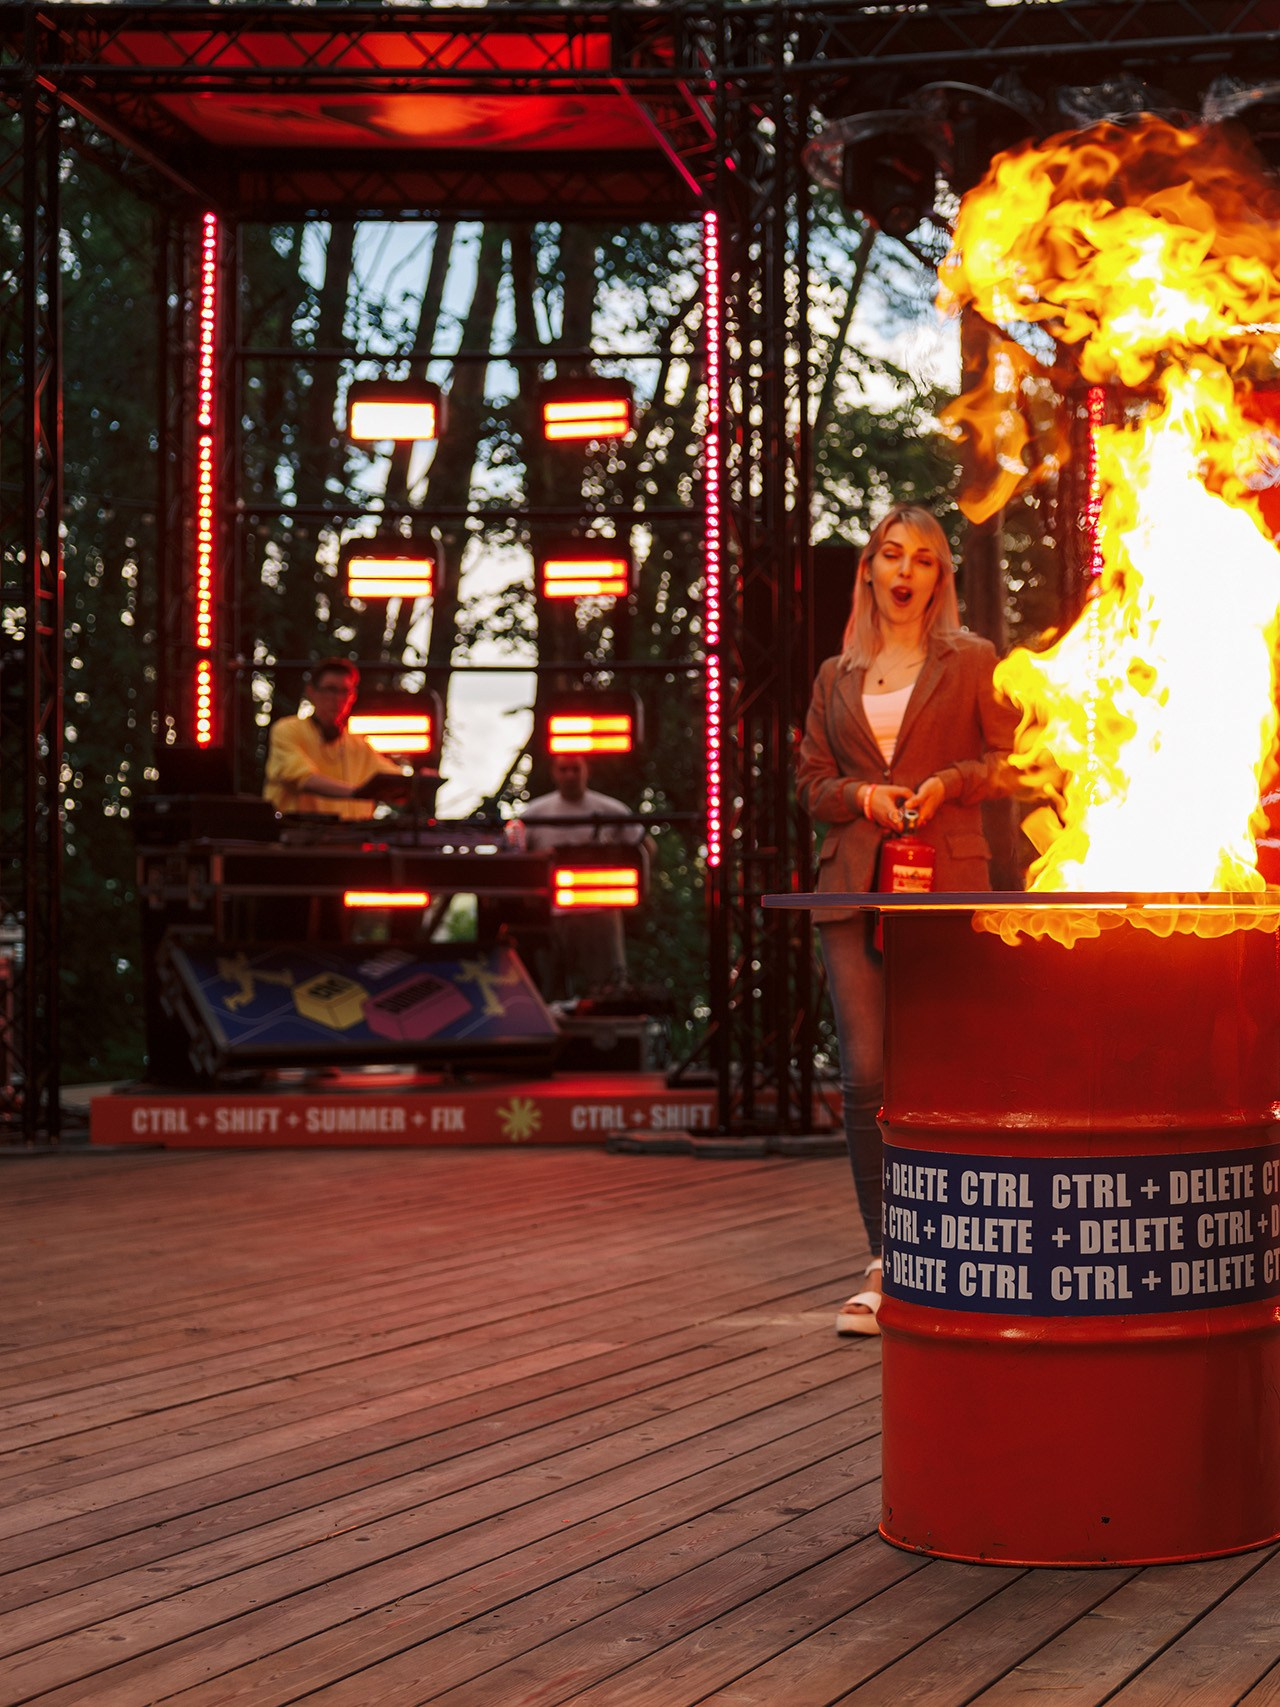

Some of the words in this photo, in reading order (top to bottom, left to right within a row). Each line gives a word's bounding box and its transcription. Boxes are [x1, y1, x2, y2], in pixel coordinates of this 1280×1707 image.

[132, 1107, 190, 1134] CTRL
[215, 1107, 281, 1133] SHIFT
[306, 1107, 406, 1133] SUMMER
[431, 1107, 466, 1132] FIX
[571, 1104, 625, 1131] CTRL
[651, 1104, 712, 1130] SHIFT
[892, 1162, 948, 1203] DELETE
[961, 1170, 1033, 1208] CTRL
[1051, 1172, 1132, 1209] CTRL
[1169, 1164, 1254, 1205] DELETE
[889, 1205, 920, 1245] CTRL
[941, 1214, 1033, 1254] DELETE
[1079, 1216, 1184, 1255] DELETE
[1197, 1209, 1254, 1249] CTRL
[893, 1250, 947, 1294] DELETE
[959, 1261, 1033, 1300] CTRL
[1050, 1265, 1133, 1301] CTRL
[1170, 1253, 1255, 1296] DELETE
